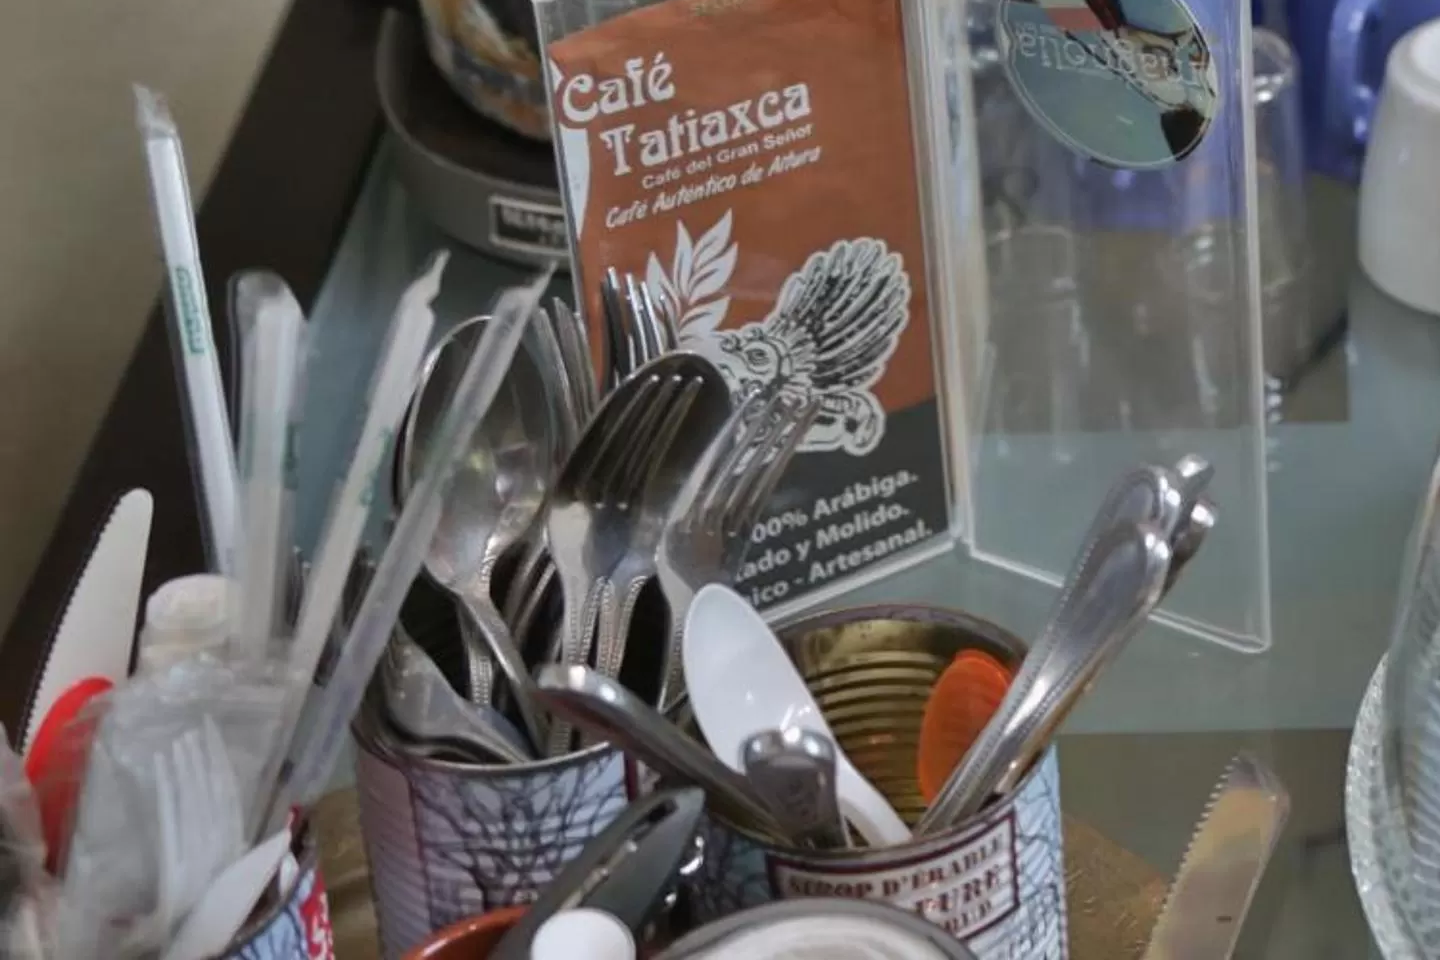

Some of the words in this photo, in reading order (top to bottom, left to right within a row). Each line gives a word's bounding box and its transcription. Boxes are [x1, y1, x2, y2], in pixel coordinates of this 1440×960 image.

[562, 51, 676, 123] Café
[598, 82, 813, 177] Tatiaxca
[686, 156, 713, 175] del
[716, 142, 760, 164] Gran
[741, 160, 764, 185] de
[736, 548, 792, 583] ado
[796, 540, 811, 563] y
[816, 501, 910, 550] Molido.
[750, 509, 809, 544] 00%
[751, 582, 790, 607] ico
[809, 518, 933, 584] Artesanal.
